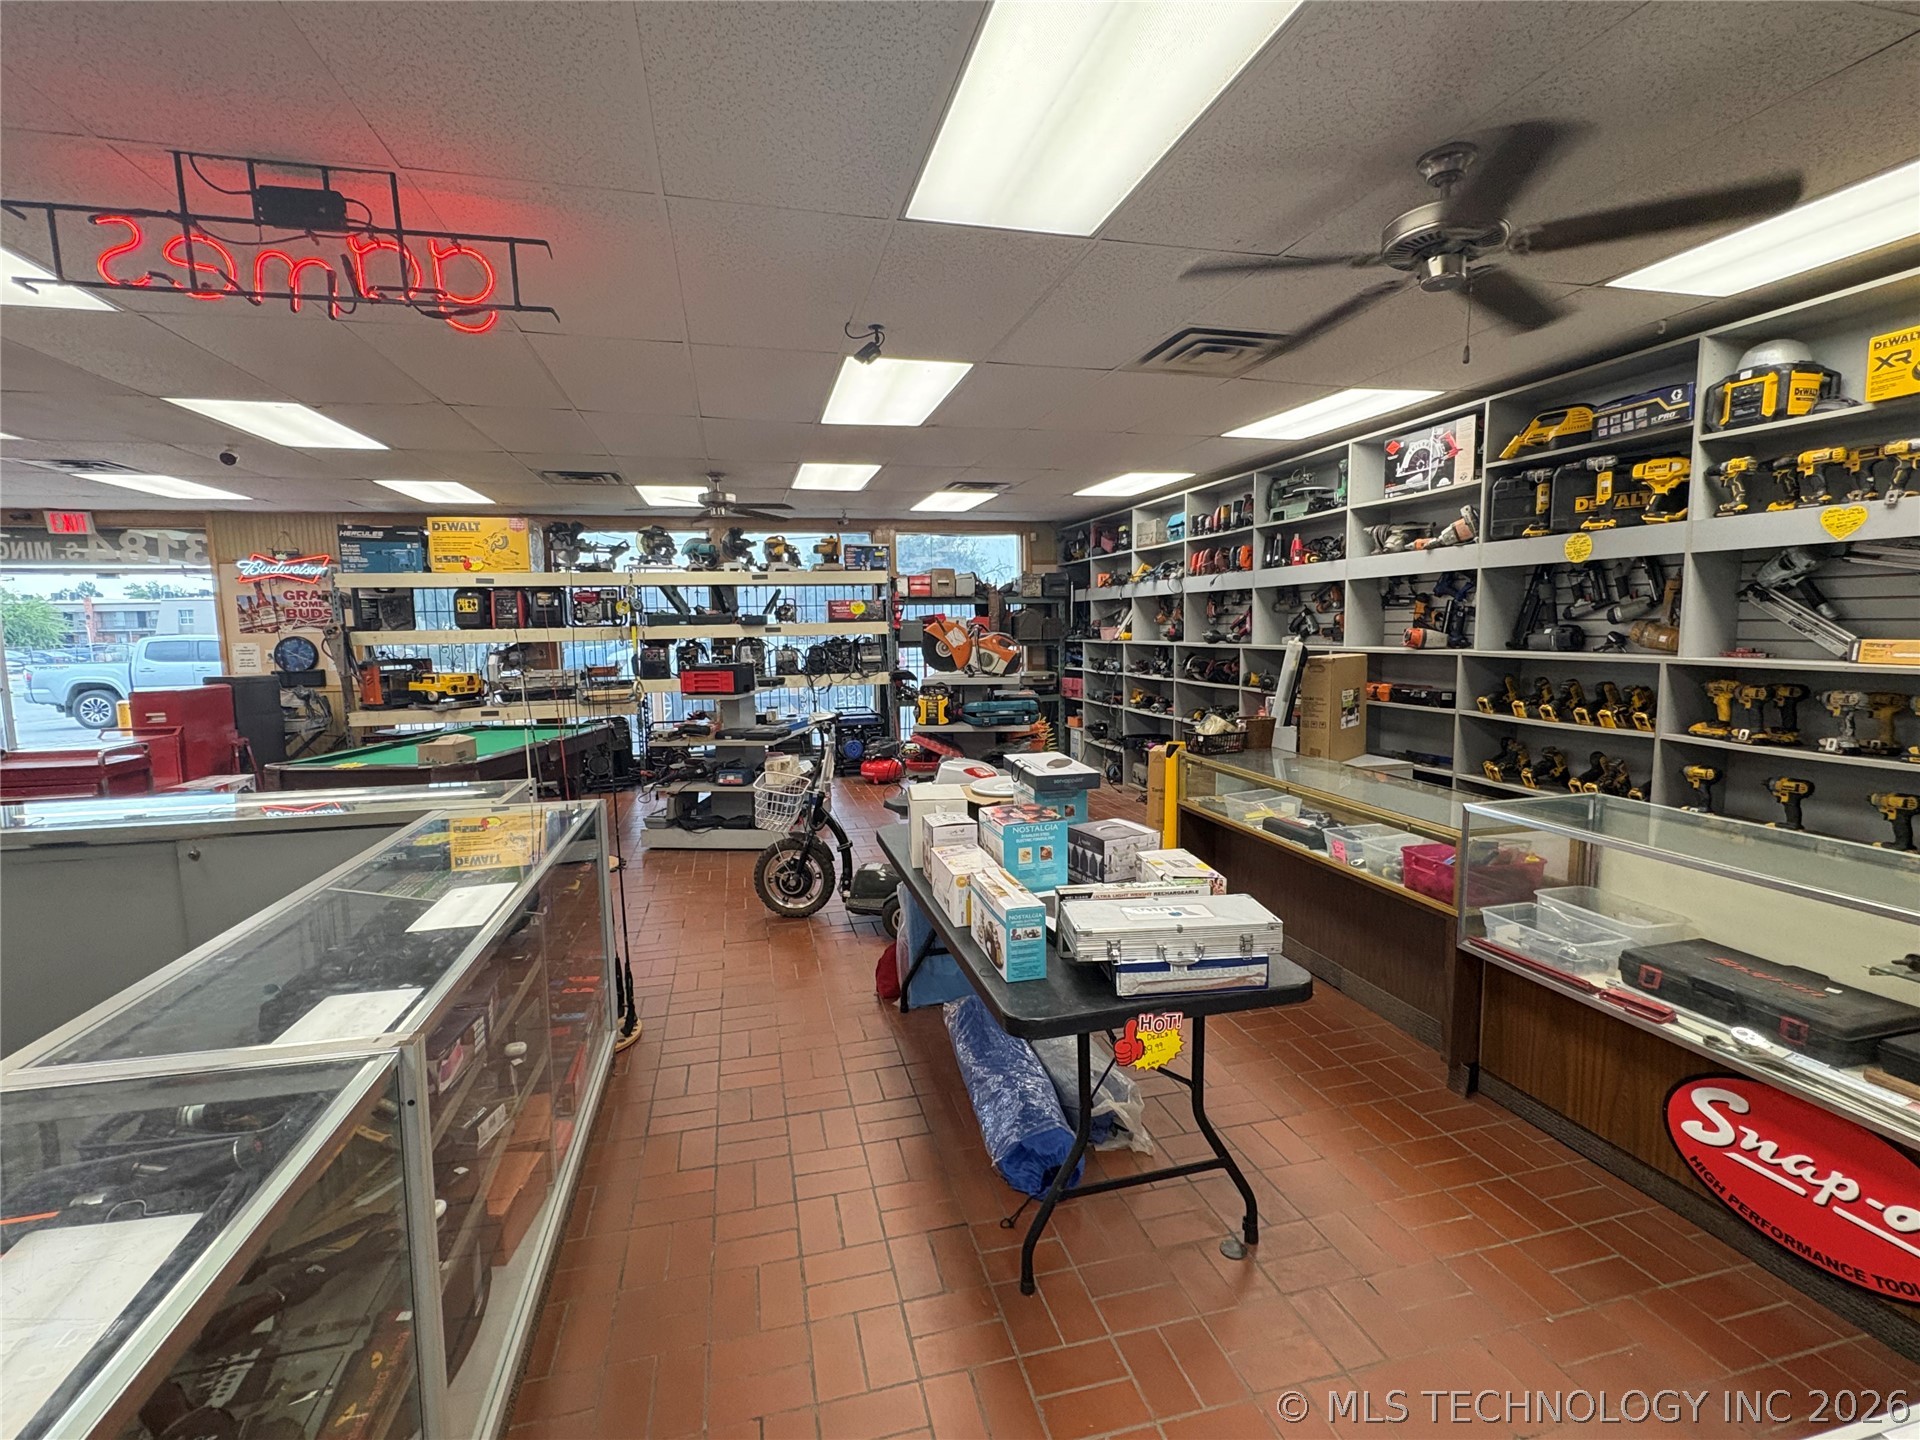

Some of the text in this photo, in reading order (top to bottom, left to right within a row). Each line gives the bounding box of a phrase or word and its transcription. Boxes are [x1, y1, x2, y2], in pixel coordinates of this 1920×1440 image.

[1873, 349, 1912, 372] XR
[1575, 492, 1650, 512] DEALT
[50, 513, 88, 533] EXIT
[432, 521, 480, 532] DEWALT
[339, 529, 384, 537] HERCULES
[236, 559, 329, 577] Budweiser
[283, 590, 332, 600] GRA
[293, 600, 325, 608] SOME
[285, 608, 333, 619] BUDS
[1012, 823, 1058, 834] NOSTALGIA
[1009, 912, 1042, 921] NOSTALGIA
[1139, 1013, 1183, 1033] HOT!
[1681, 1087, 1920, 1233] Snap-o
[1690, 1155, 1726, 1194] HIGH
[1728, 1194, 1868, 1283] PERFORMANCE
